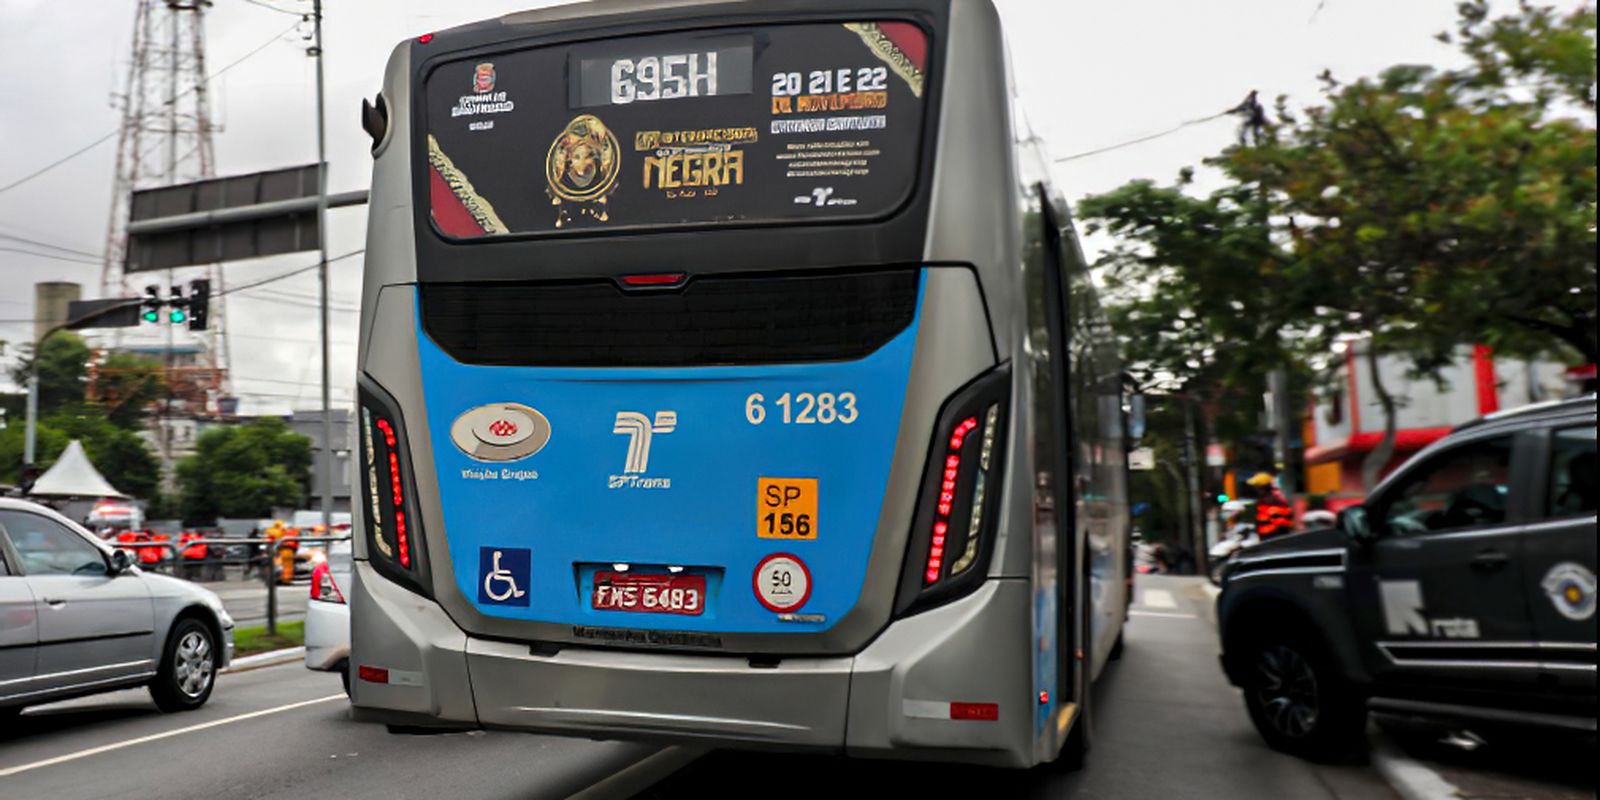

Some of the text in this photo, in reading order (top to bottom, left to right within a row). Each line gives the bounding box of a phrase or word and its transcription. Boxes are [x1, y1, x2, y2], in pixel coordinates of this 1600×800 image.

[611, 52, 717, 104] 695H
[772, 67, 888, 96] 20 21 E 22
[643, 150, 744, 190] NEGRA
[745, 392, 859, 424] 6 1283
[765, 484, 801, 507] SP
[764, 513, 811, 536] 156
[597, 585, 698, 611] FMS 6483
